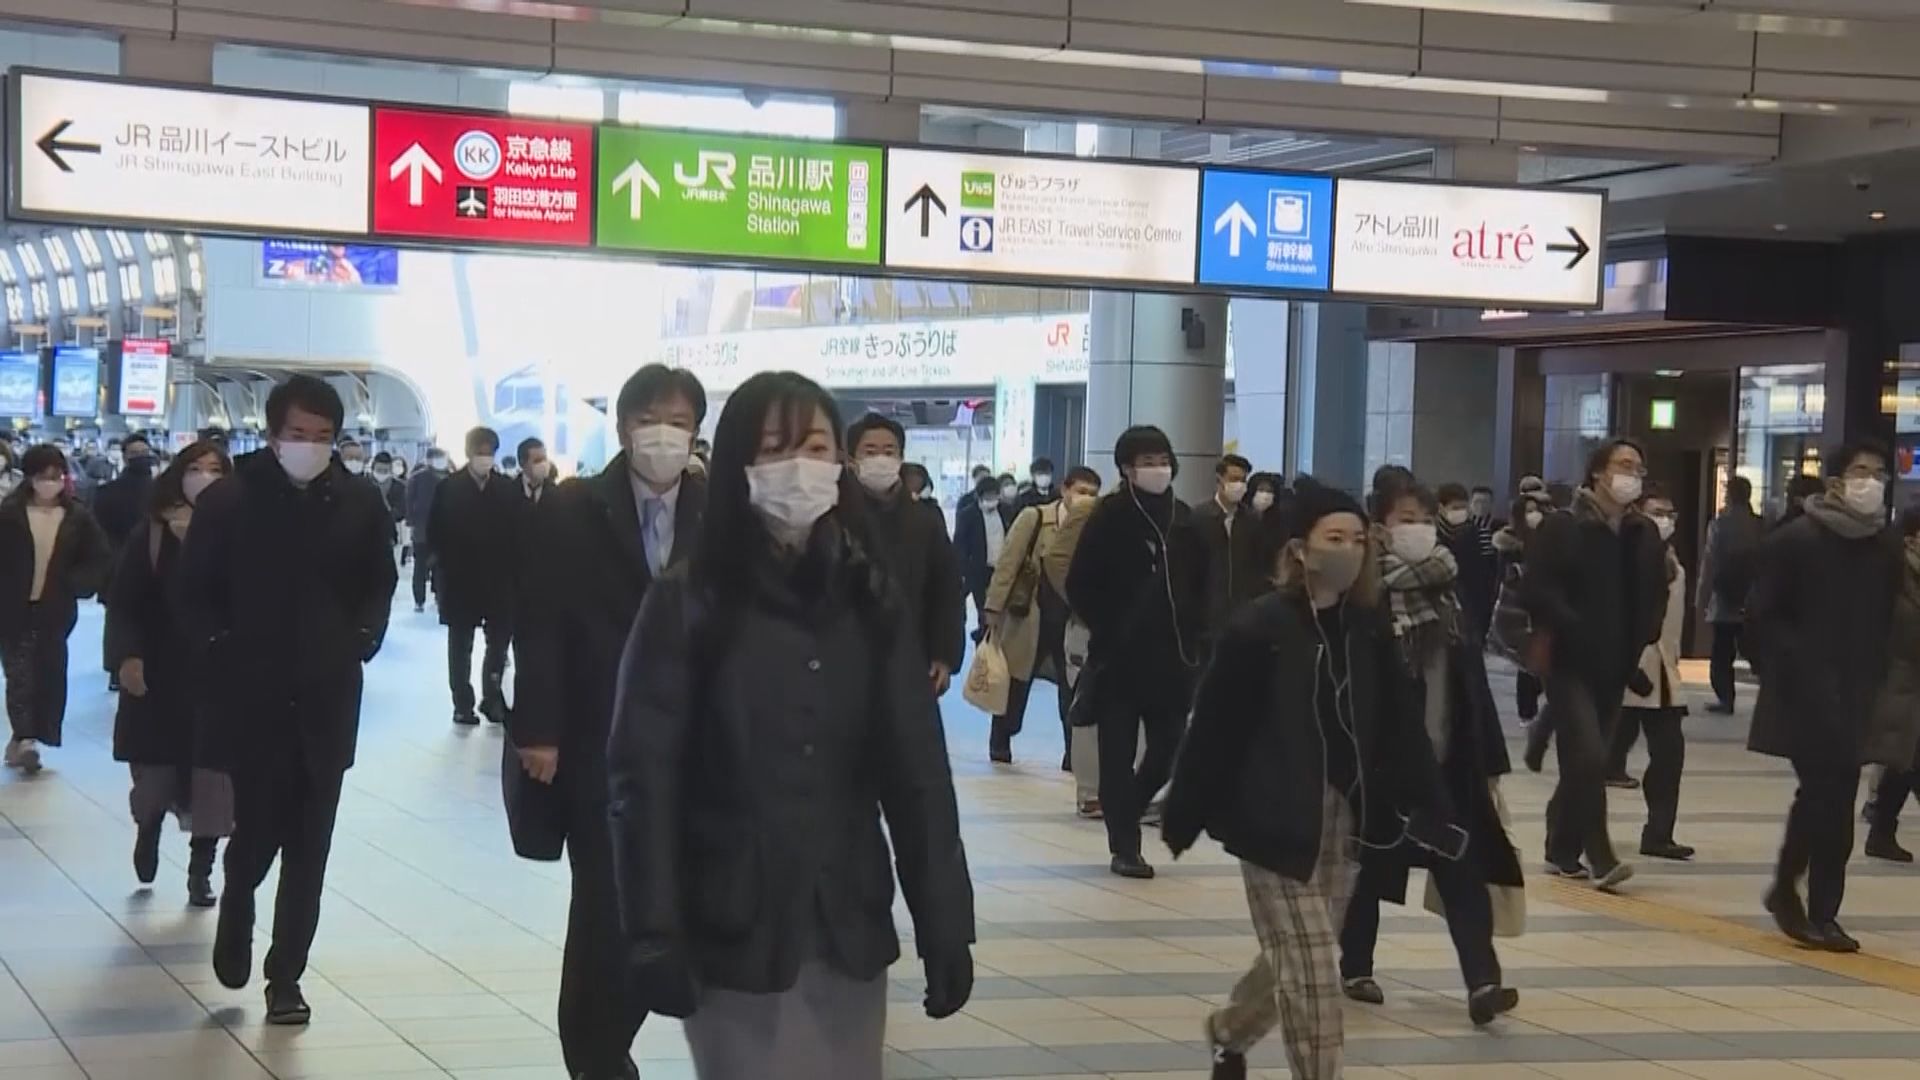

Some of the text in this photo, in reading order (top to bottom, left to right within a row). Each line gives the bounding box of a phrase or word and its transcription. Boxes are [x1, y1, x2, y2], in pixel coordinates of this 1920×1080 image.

[115, 123, 347, 163] JR 品川イーストビル
[464, 145, 491, 164] KK
[506, 135, 573, 162] 京急線
[115, 157, 344, 186] JR Shinagawa East Building
[550, 164, 576, 180] Line
[673, 150, 737, 190] JR
[747, 154, 833, 192] 品川駅
[681, 187, 729, 203] JR東日本
[1000, 173, 1080, 193] びゅうプラザ
[494, 186, 578, 210] 羽田空港方面
[747, 192, 832, 217] Shinagawa
[494, 207, 574, 224] for Haneda Airport
[747, 215, 800, 236] Station
[1354, 213, 1440, 240] アトレ品川
[999, 217, 1183, 242] JR EAST Travel Service Center
[1452, 220, 1535, 264] atré
[1266, 242, 1312, 262] 新幹線
[1376, 242, 1438, 257] Shinagawa
[1265, 260, 1317, 275] Shinkansen
[821, 330, 959, 359] JR全線 きっぷうりば
[1047, 322, 1072, 347] JR
